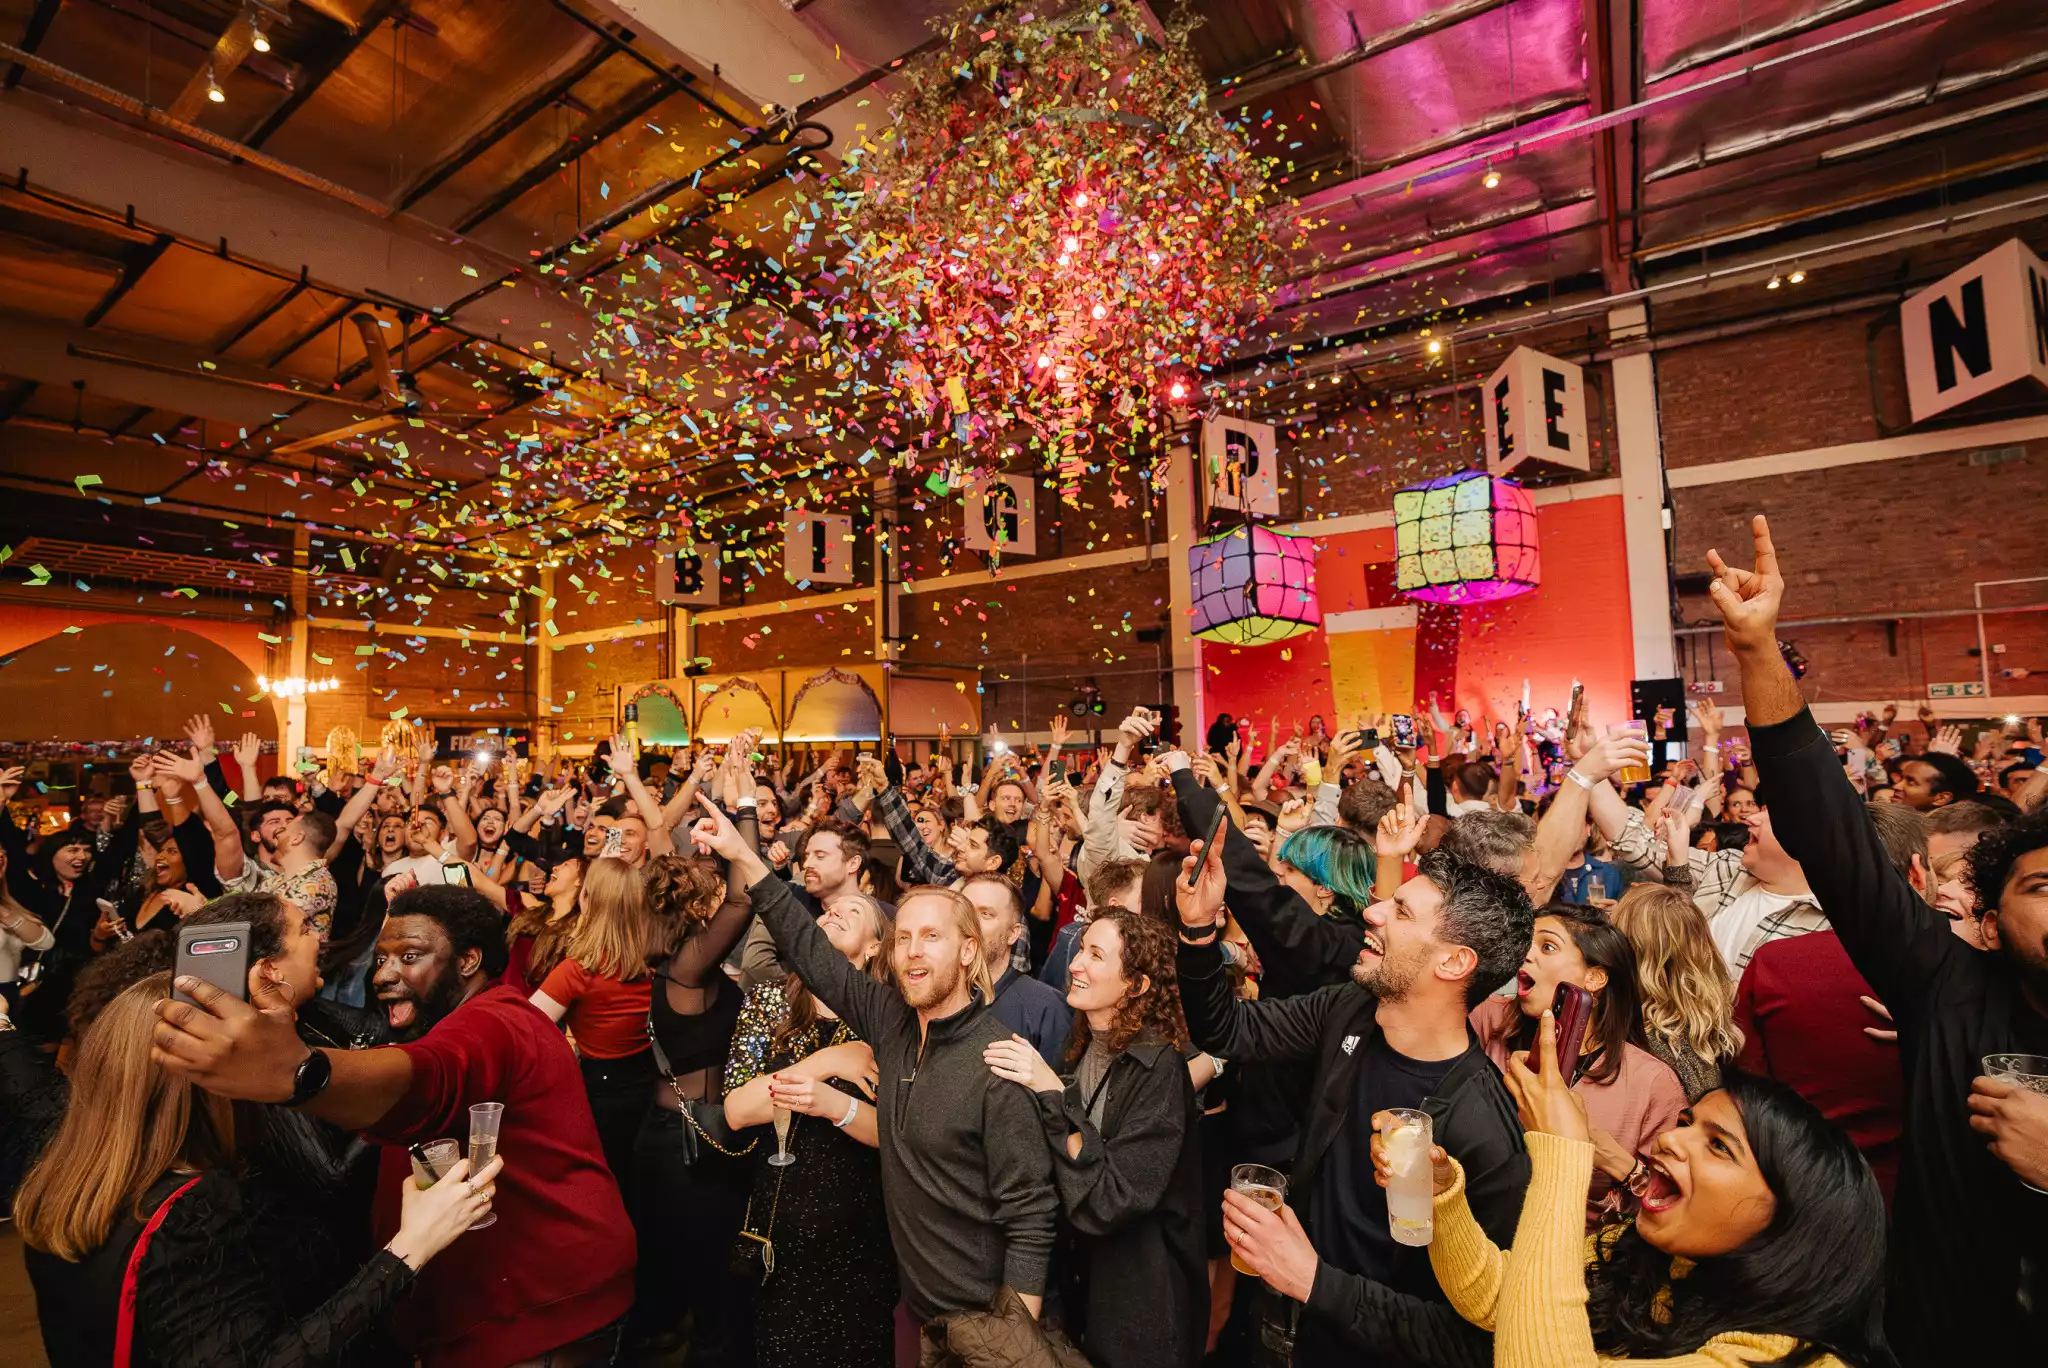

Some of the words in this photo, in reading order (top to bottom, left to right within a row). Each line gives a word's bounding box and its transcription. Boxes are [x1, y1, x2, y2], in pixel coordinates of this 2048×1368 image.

[1928, 274, 1993, 394] N
[1494, 374, 1514, 462] E
[1541, 367, 1571, 452] E
[812, 520, 826, 573] I
[983, 482, 1018, 543] G
[674, 549, 705, 595] B
